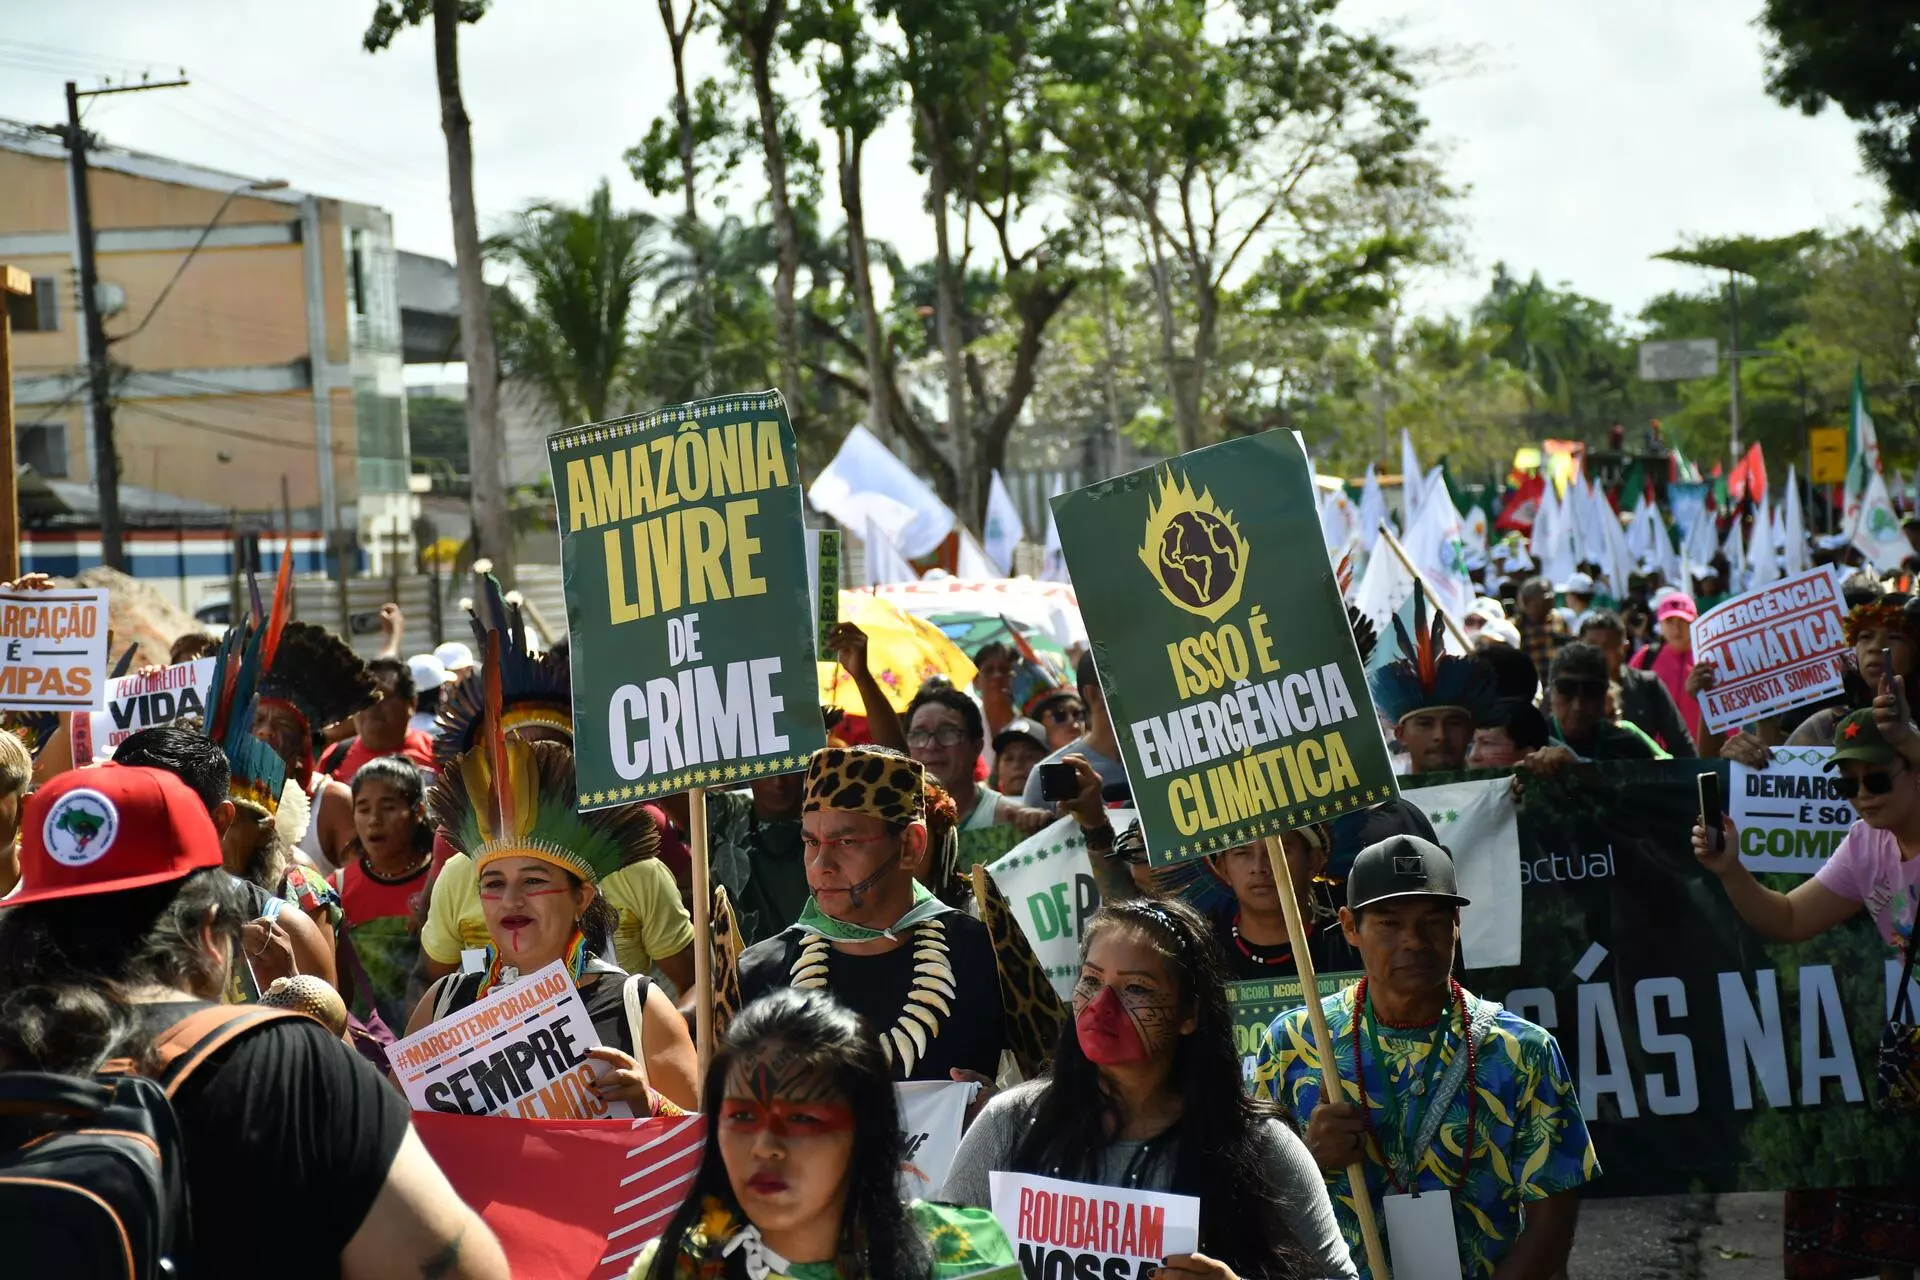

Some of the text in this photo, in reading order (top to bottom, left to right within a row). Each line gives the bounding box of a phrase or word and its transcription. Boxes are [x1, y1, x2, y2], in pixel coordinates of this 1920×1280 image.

[567, 420, 789, 532] AMAZÔNIA
[603, 498, 767, 626] LIVRE
[0, 603, 97, 645] RCAÇÃO
[667, 612, 703, 667] DE
[1700, 577, 1833, 638] EMERGÊNCIA
[6, 639, 22, 662] É
[1166, 604, 1281, 700] ISSO É
[1701, 609, 1845, 686] CLIMÁTICA
[107, 687, 206, 731] VIDA
[608, 656, 790, 781] CRIME
[1130, 662, 1358, 779] EMERGÊNCIA
[1708, 695, 1720, 717] A
[1721, 680, 1784, 712] RESPOSTA
[1784, 662, 1833, 691] SOMOS
[1168, 731, 1361, 837] CLIMÁTICA
[1746, 773, 1842, 802] DEMARC
[1799, 803, 1852, 825] É SÓ
[396, 972, 567, 1071] #MARCOTEMPORALNÃO
[1240, 984, 1270, 1000] AGORA
[1273, 981, 1305, 998] AGORA
[424, 1015, 588, 1117] SEMPRE
[1717, 964, 1864, 1110] NA
[1017, 1187, 1165, 1260] ROUBARAM
